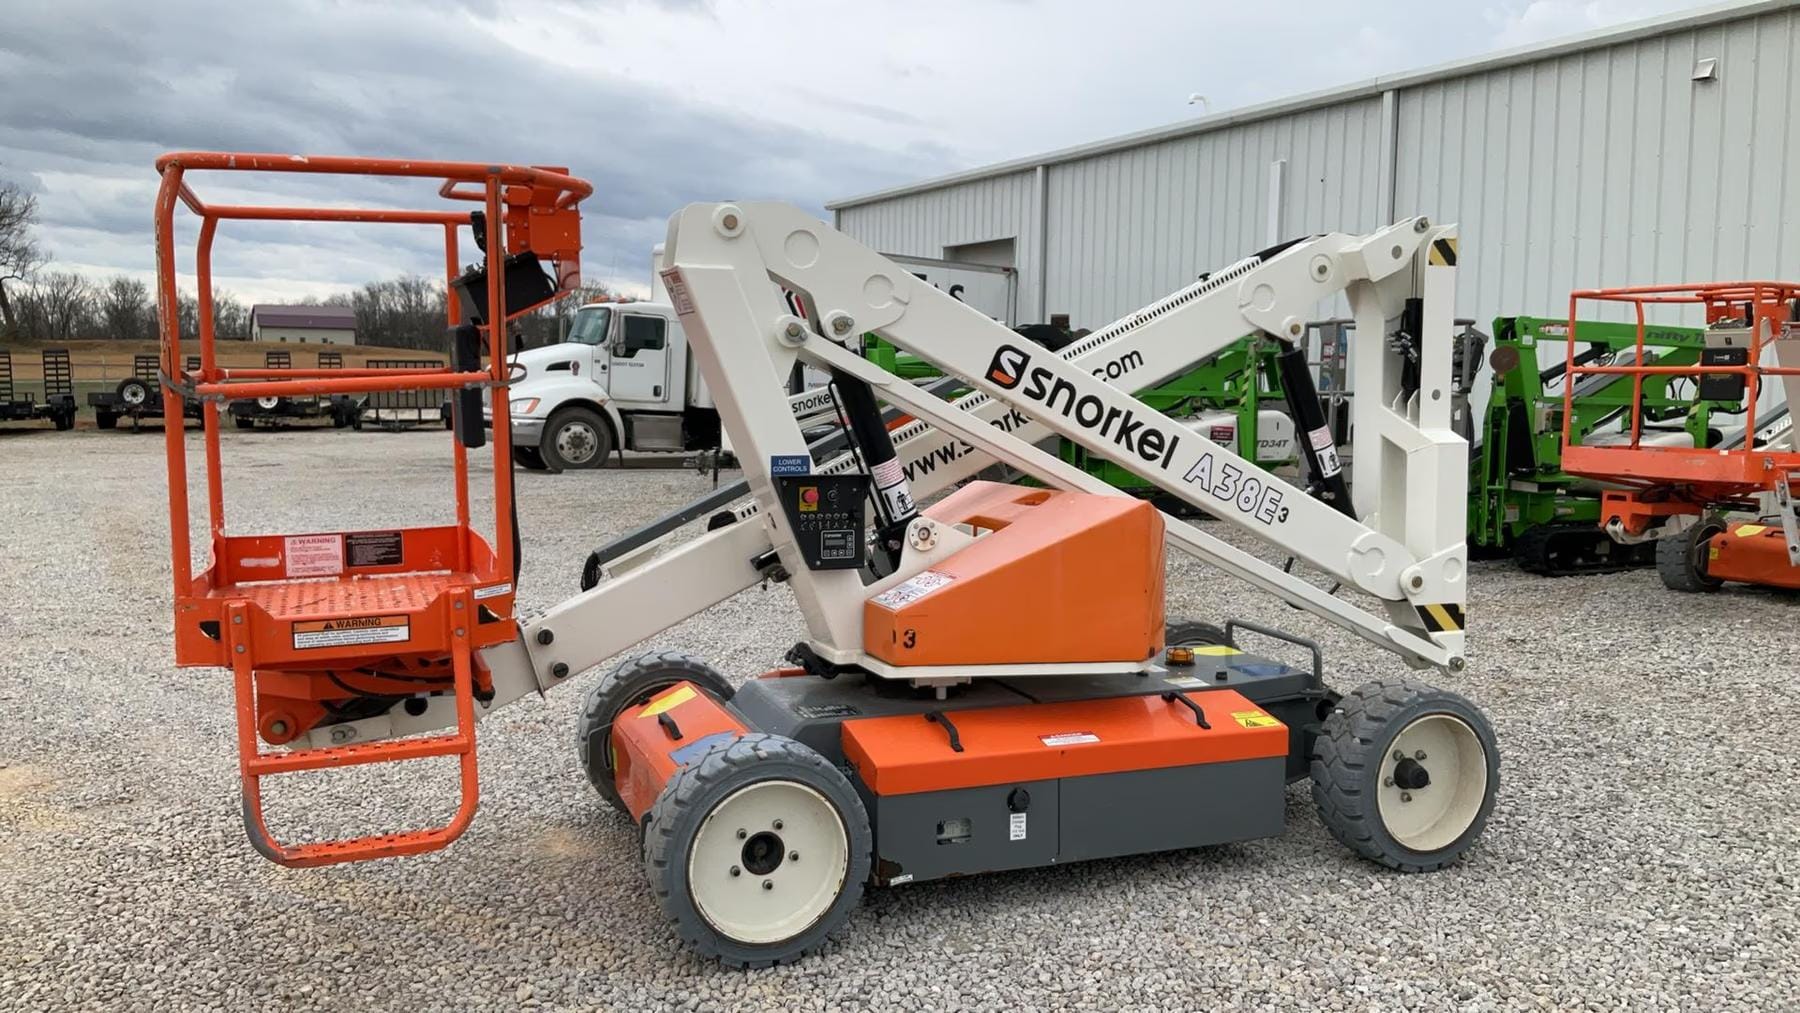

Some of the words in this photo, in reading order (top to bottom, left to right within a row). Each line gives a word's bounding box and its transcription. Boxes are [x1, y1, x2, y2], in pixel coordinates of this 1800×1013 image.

[791, 393, 832, 413] snorke
[1022, 366, 1180, 470] snorkel
[1183, 452, 1284, 525] A38E
[298, 537, 336, 545] WARNING
[336, 618, 381, 628] WARNING
